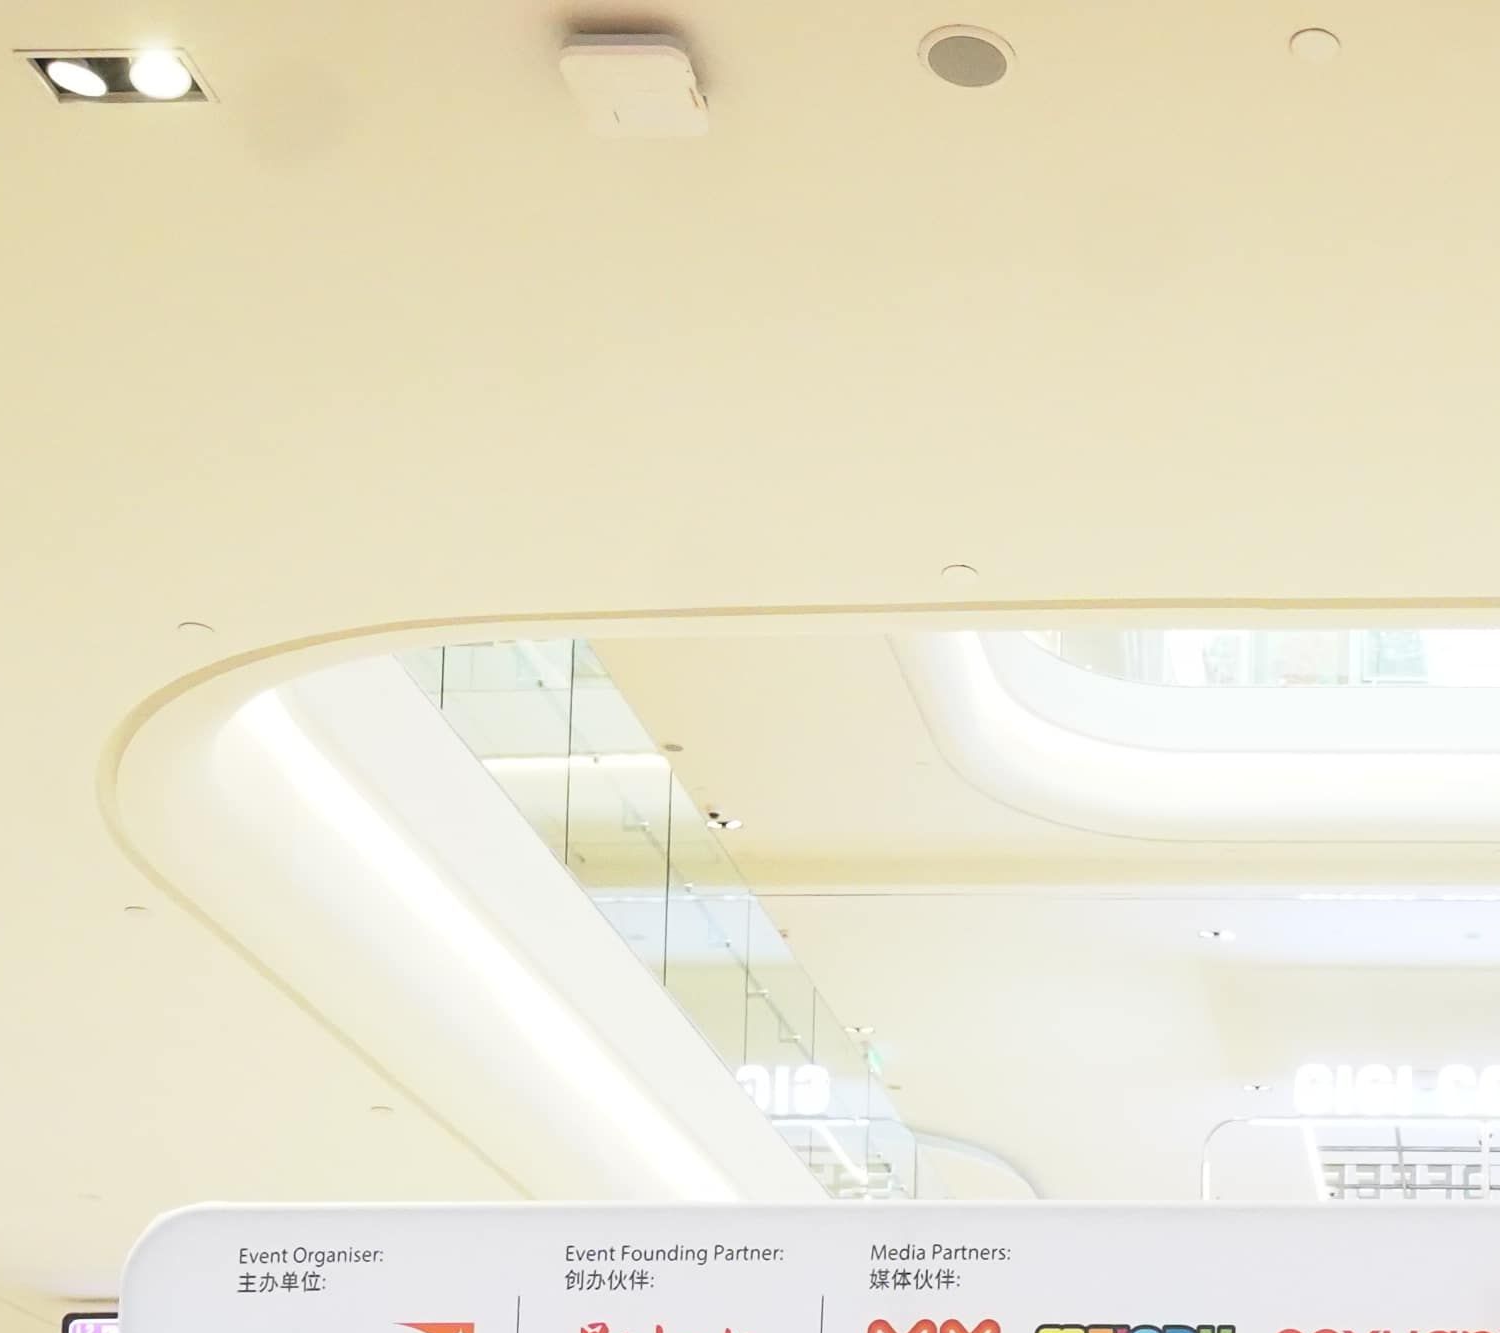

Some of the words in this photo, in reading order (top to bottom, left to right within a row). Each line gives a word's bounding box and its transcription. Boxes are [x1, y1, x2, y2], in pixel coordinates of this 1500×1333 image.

[240, 1248, 288, 1264] Event
[293, 1247, 383, 1267] Organiser:
[566, 1245, 615, 1261] Event
[622, 1245, 707, 1265] Founding
[714, 1245, 783, 1261] Partner:
[871, 1244, 925, 1260] Media
[932, 1244, 1010, 1260] Partners:
[237, 1271, 326, 1292] 主办单位:
[565, 1269, 654, 1291] 创办伙伴:
[870, 1269, 960, 1290] 媒体伙伴:
